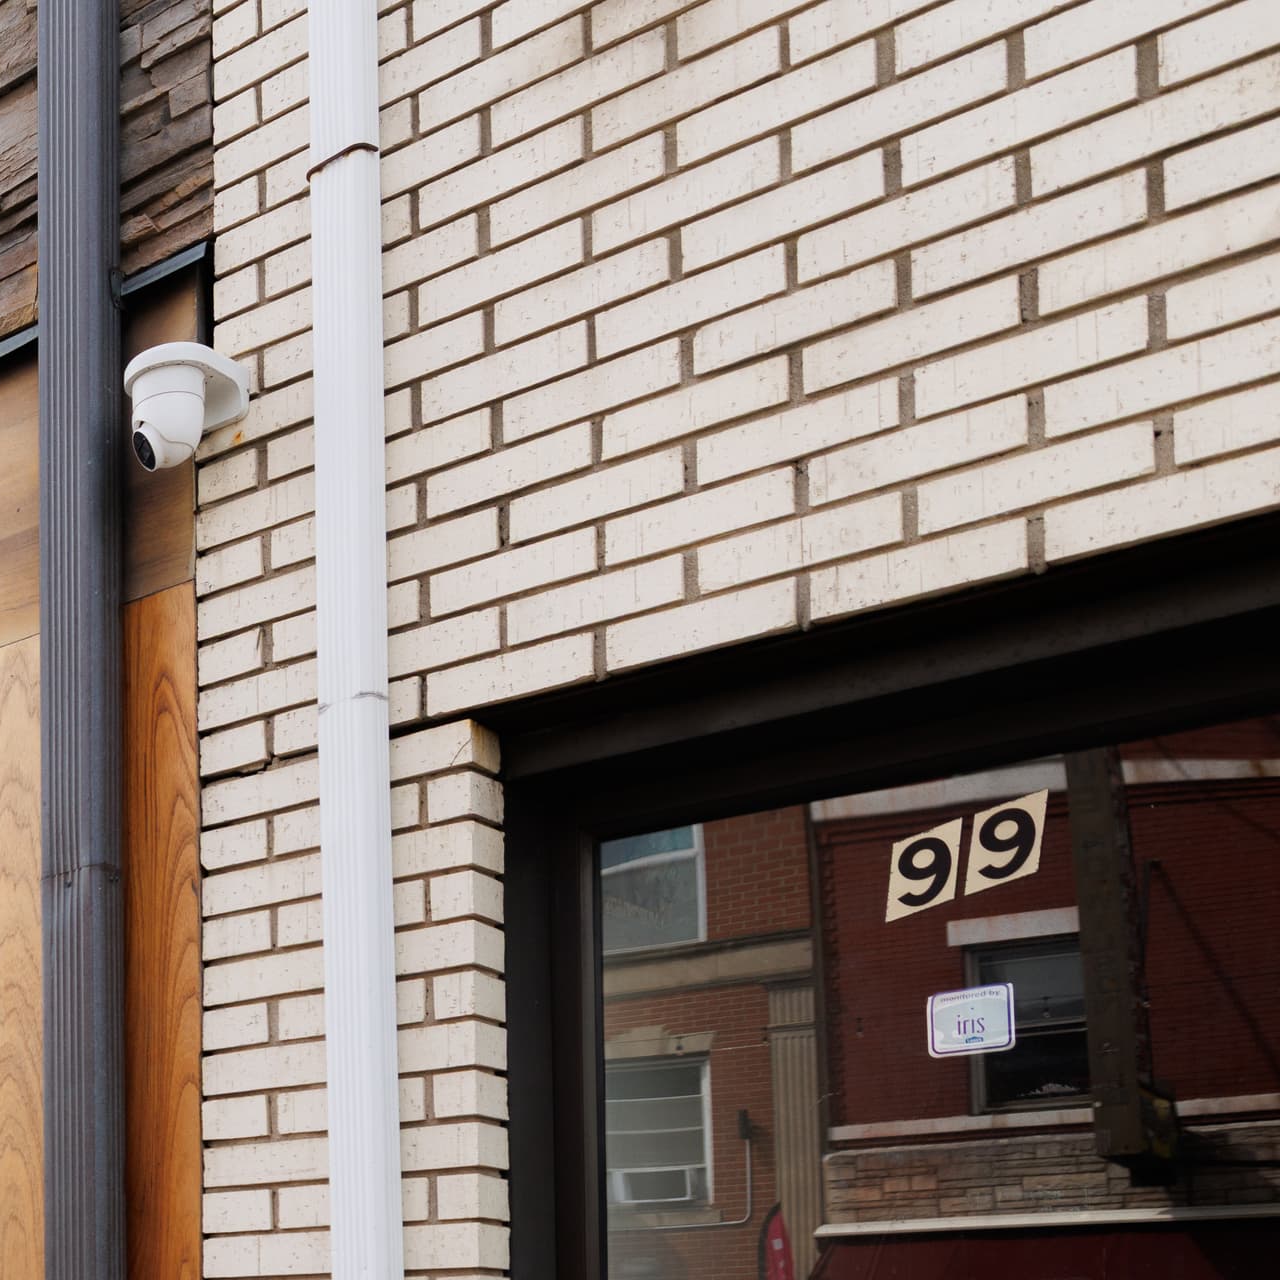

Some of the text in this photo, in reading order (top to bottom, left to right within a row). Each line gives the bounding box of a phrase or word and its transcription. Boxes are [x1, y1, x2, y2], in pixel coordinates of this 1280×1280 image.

[896, 807, 1036, 907] 99
[942, 989, 1001, 1002] monitored by
